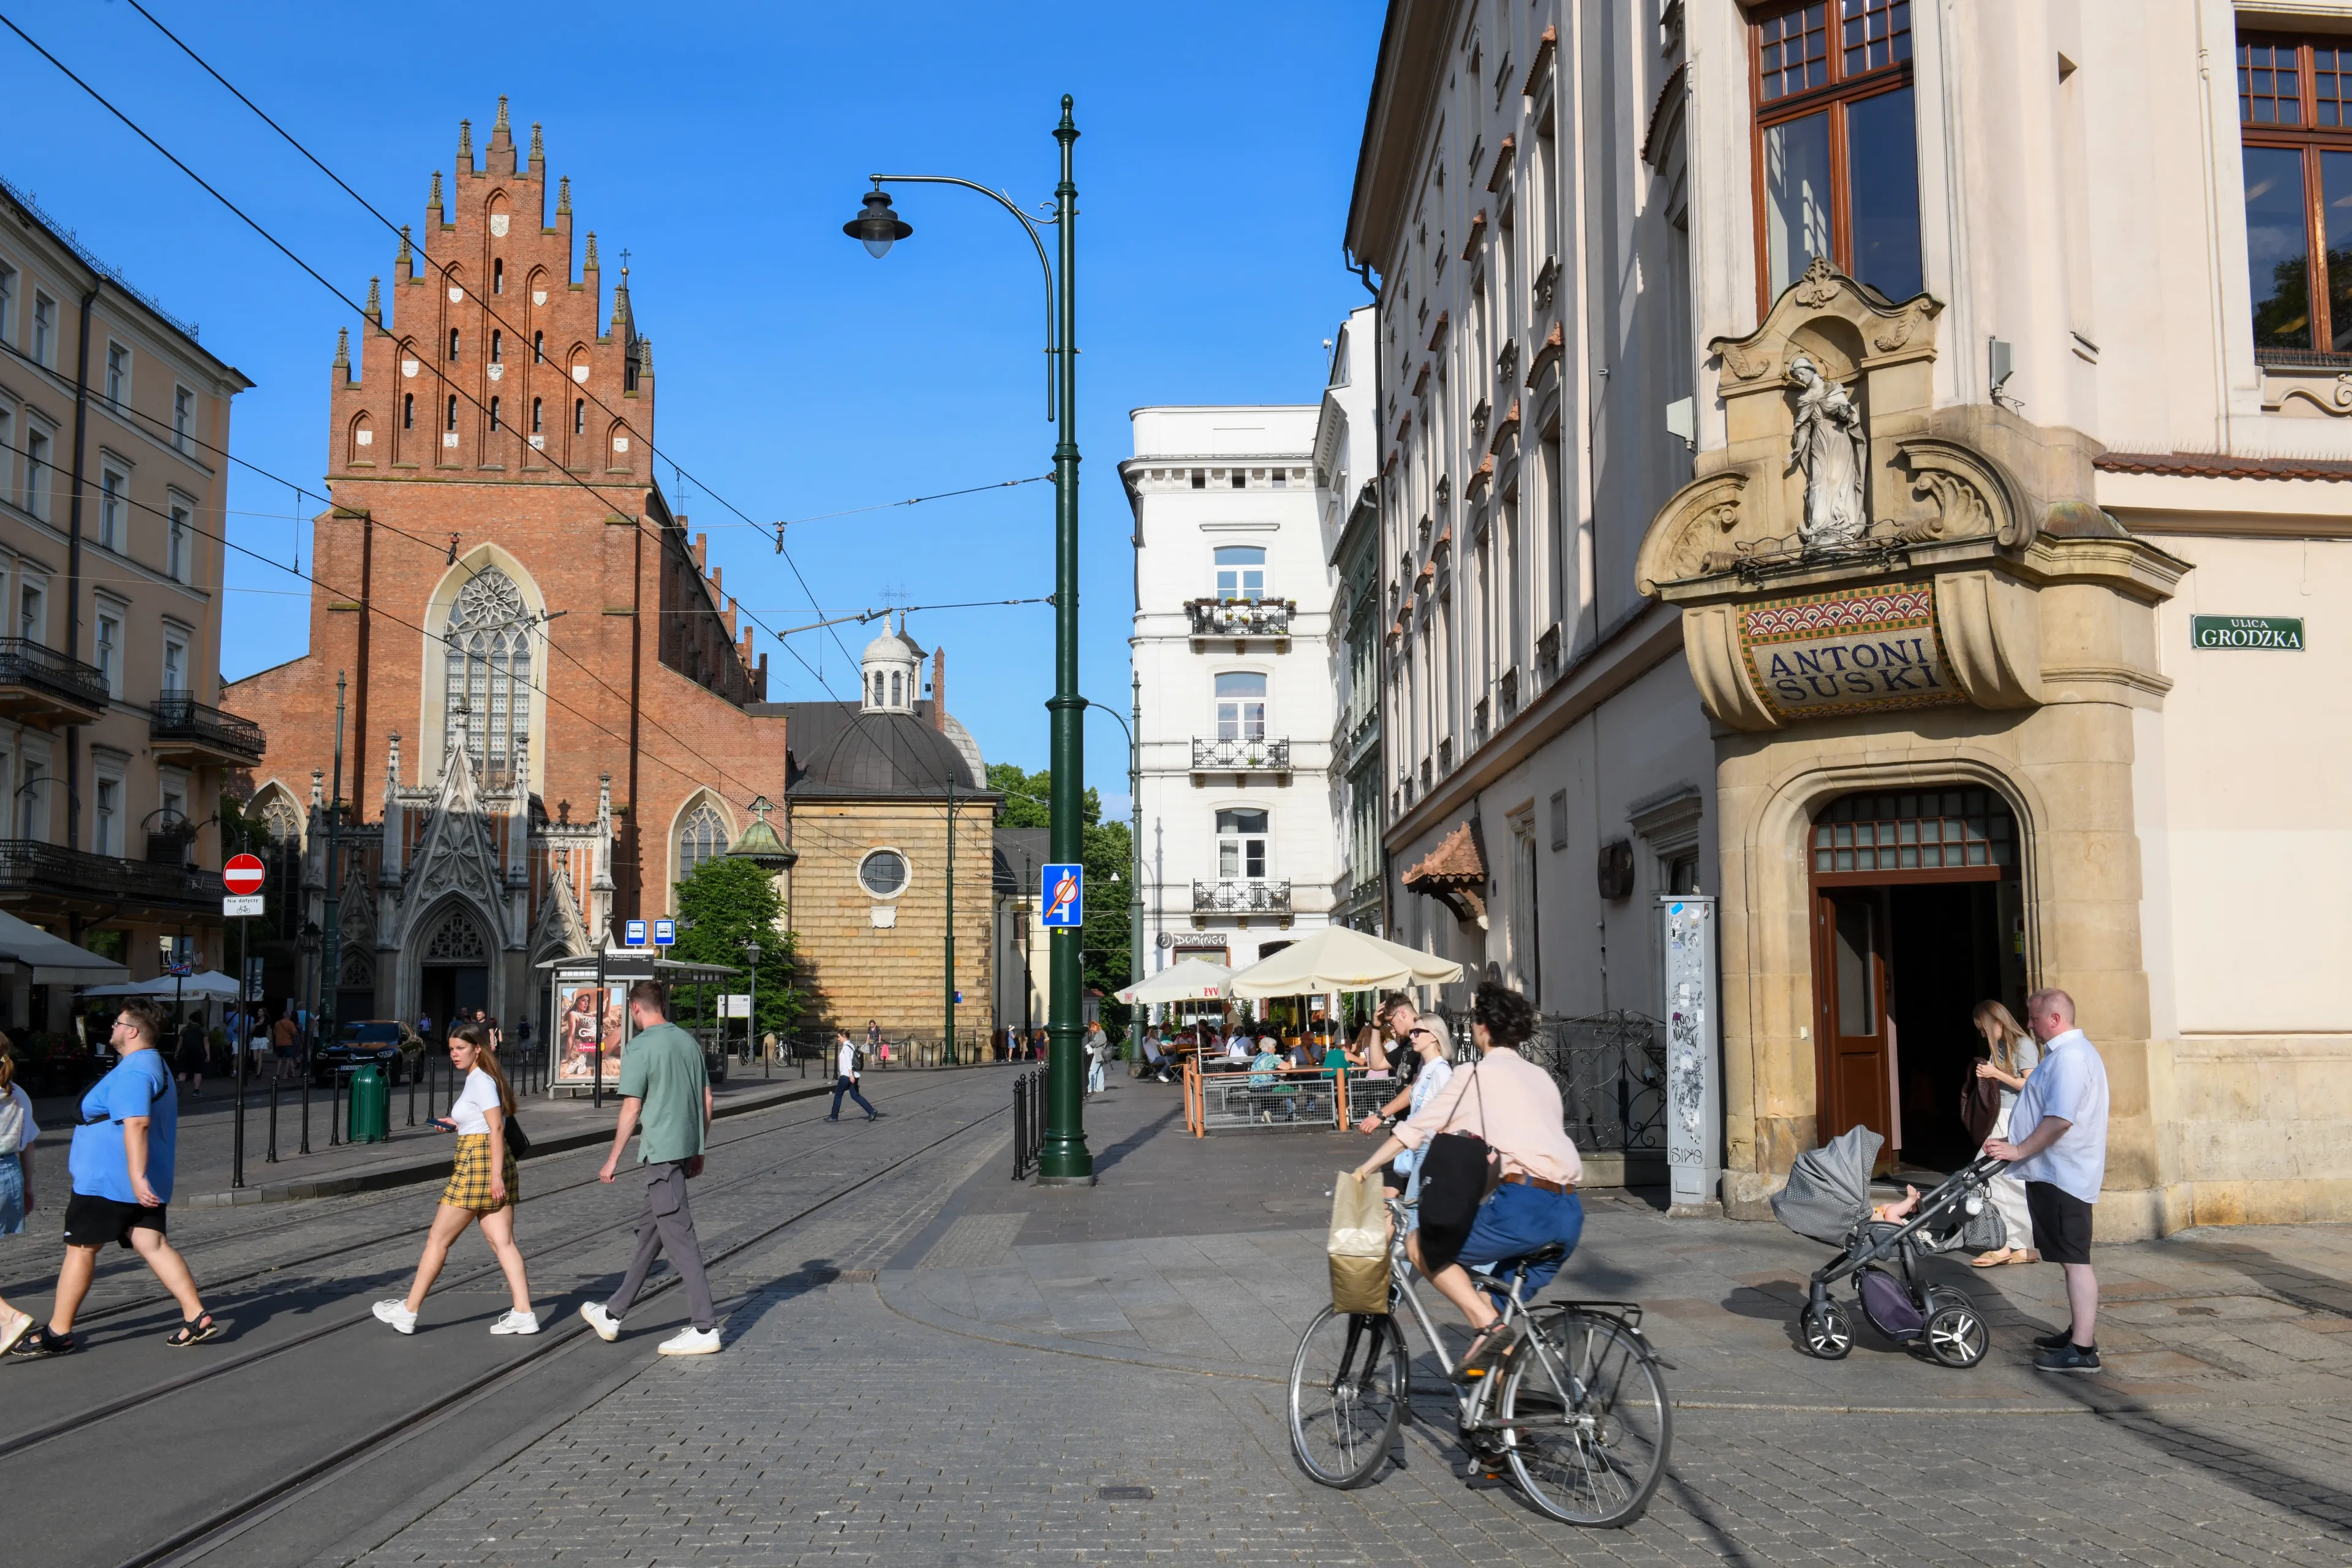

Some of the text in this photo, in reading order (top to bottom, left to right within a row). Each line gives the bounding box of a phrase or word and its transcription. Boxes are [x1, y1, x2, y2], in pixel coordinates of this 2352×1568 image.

[2231, 619, 2269, 628] ULICA
[2201, 629, 2301, 647] GRODZKA
[1770, 638, 1928, 678] ANTONI
[1776, 665, 1941, 701] SUSKI
[171, 964, 190, 973] TAXI
